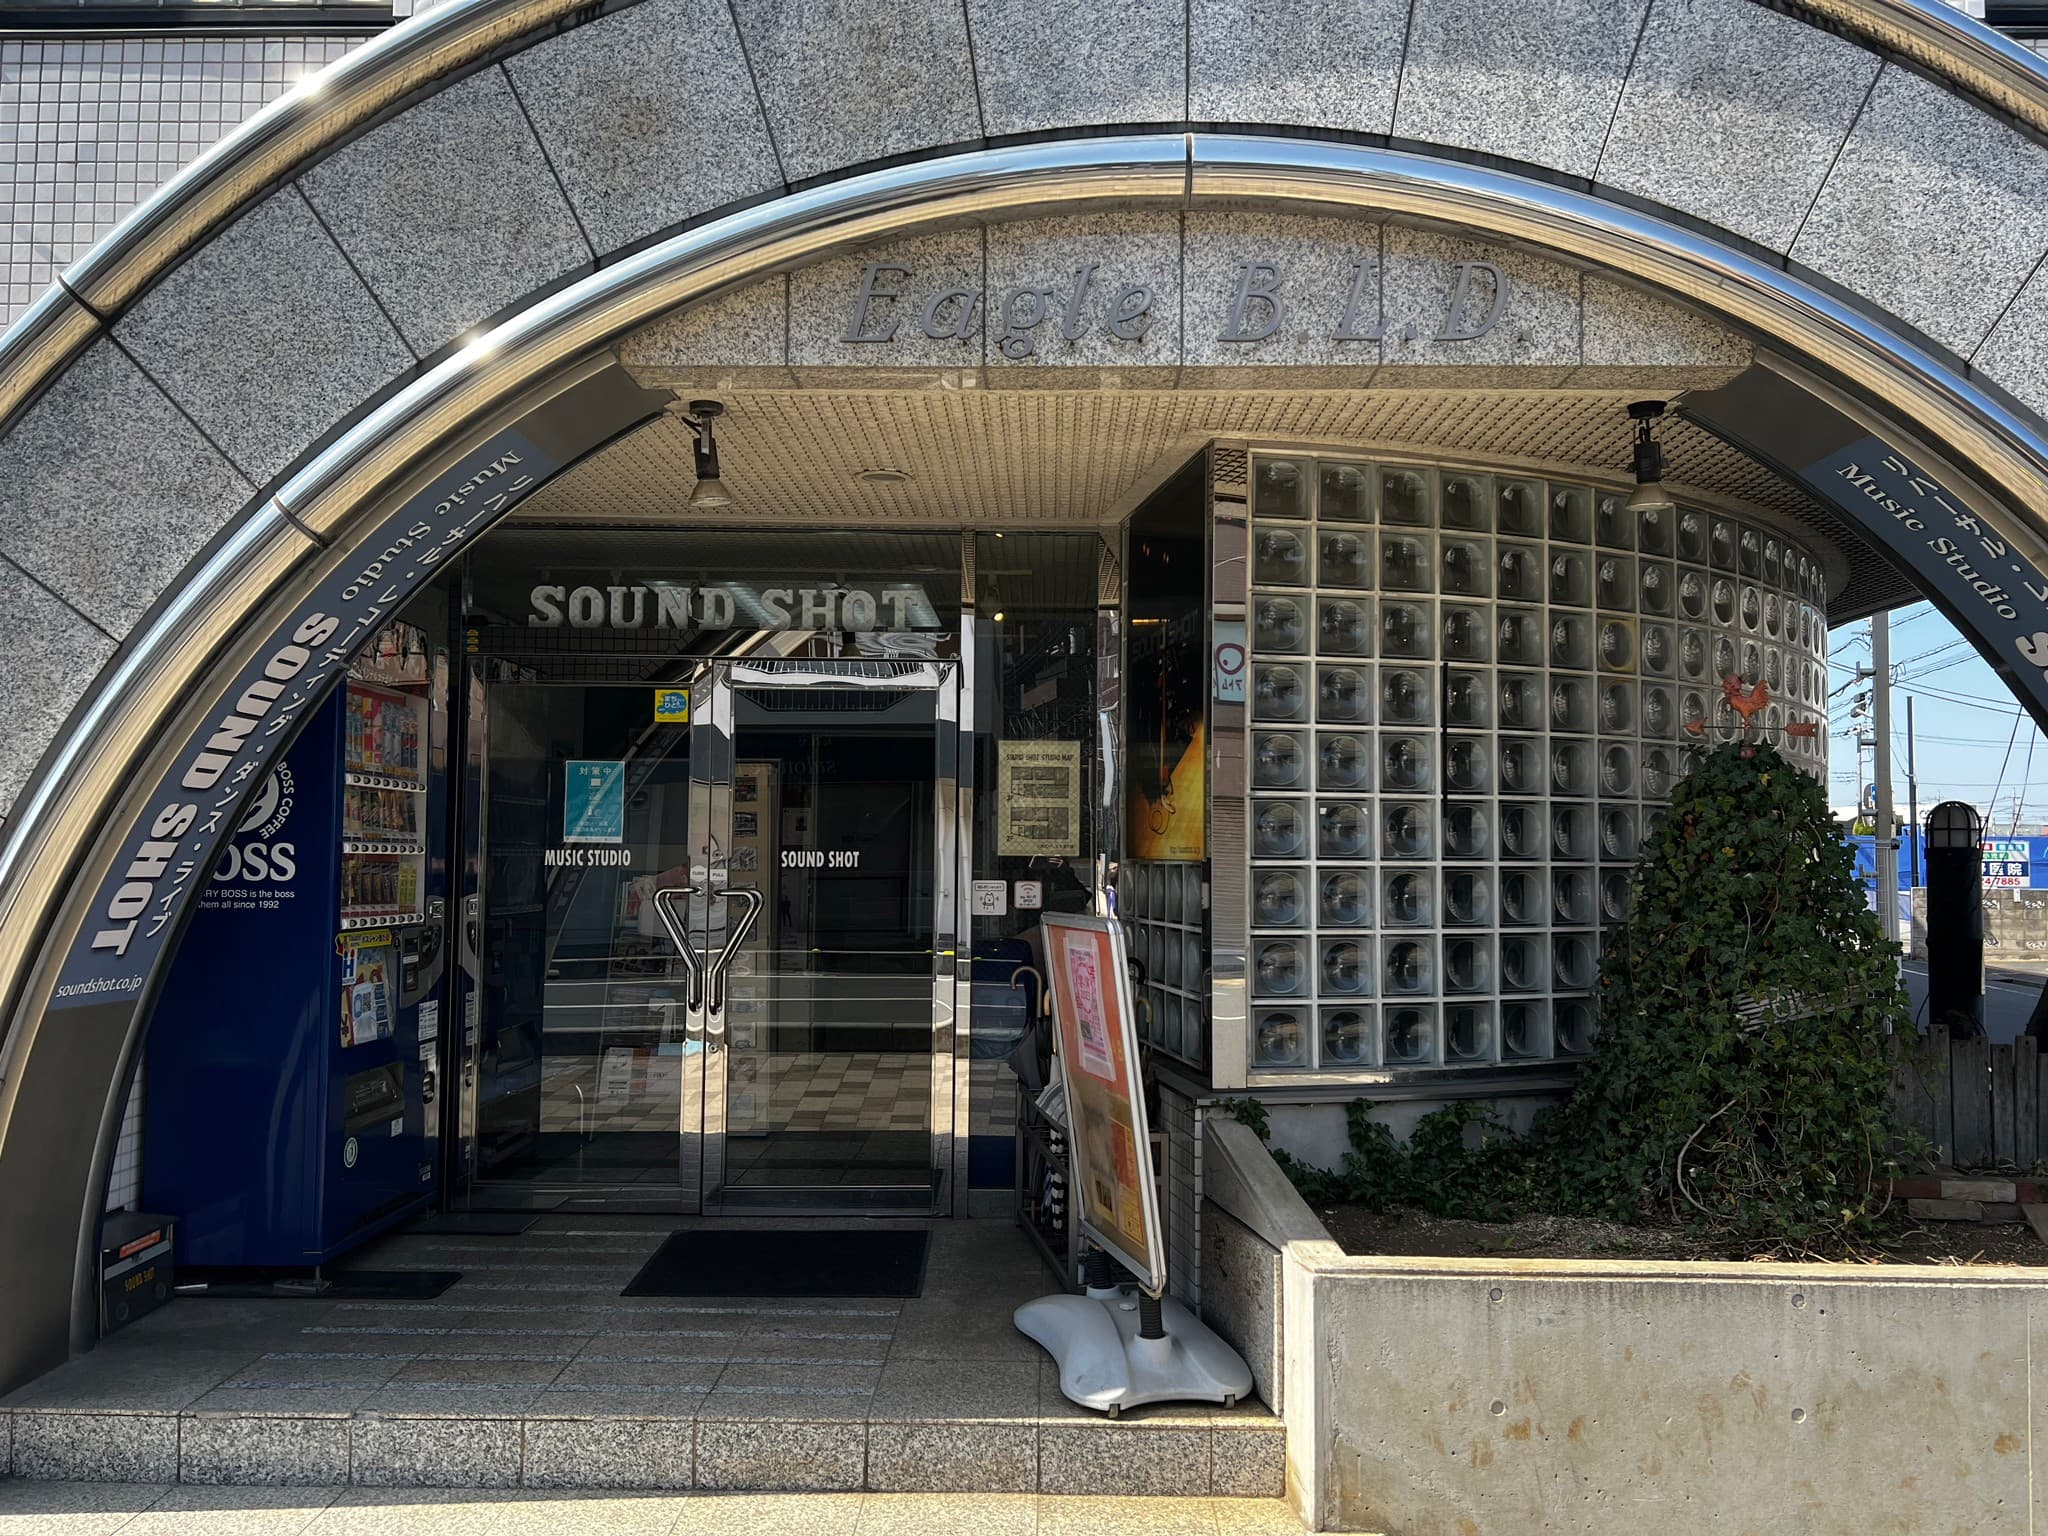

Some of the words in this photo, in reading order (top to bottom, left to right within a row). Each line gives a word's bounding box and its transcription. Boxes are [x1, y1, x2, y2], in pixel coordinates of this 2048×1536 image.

[838, 262, 1156, 359] Eagle
[1217, 260, 1534, 345] B.L.D.
[433, 449, 525, 519] Music
[340, 520, 432, 602] Studio
[1835, 463, 1925, 532] Music
[1926, 537, 2018, 620] Studio
[527, 582, 734, 630] SOUND
[761, 582, 923, 630] SHOT
[181, 611, 340, 791] SOUND
[277, 762, 295, 794] BOSS
[259, 797, 293, 840] COFFEE
[90, 802, 199, 957] SHOT
[213, 842, 296, 882] OSS
[544, 850, 583, 867] MUSIC
[587, 850, 631, 867] STUDIO
[781, 851, 824, 868] SOUND
[828, 851, 859, 868] SHOT
[199, 900, 219, 909] hem
[221, 900, 231, 909] all
[233, 900, 256, 909] since
[258, 900, 280, 909] 1992
[204, 889, 219, 898] RY
[221, 889, 248, 898] BOSS
[249, 889, 257, 898] is
[258, 889, 272, 898] the
[274, 889, 295, 898] boss
[56, 974, 142, 998] soundshot.co.jp
